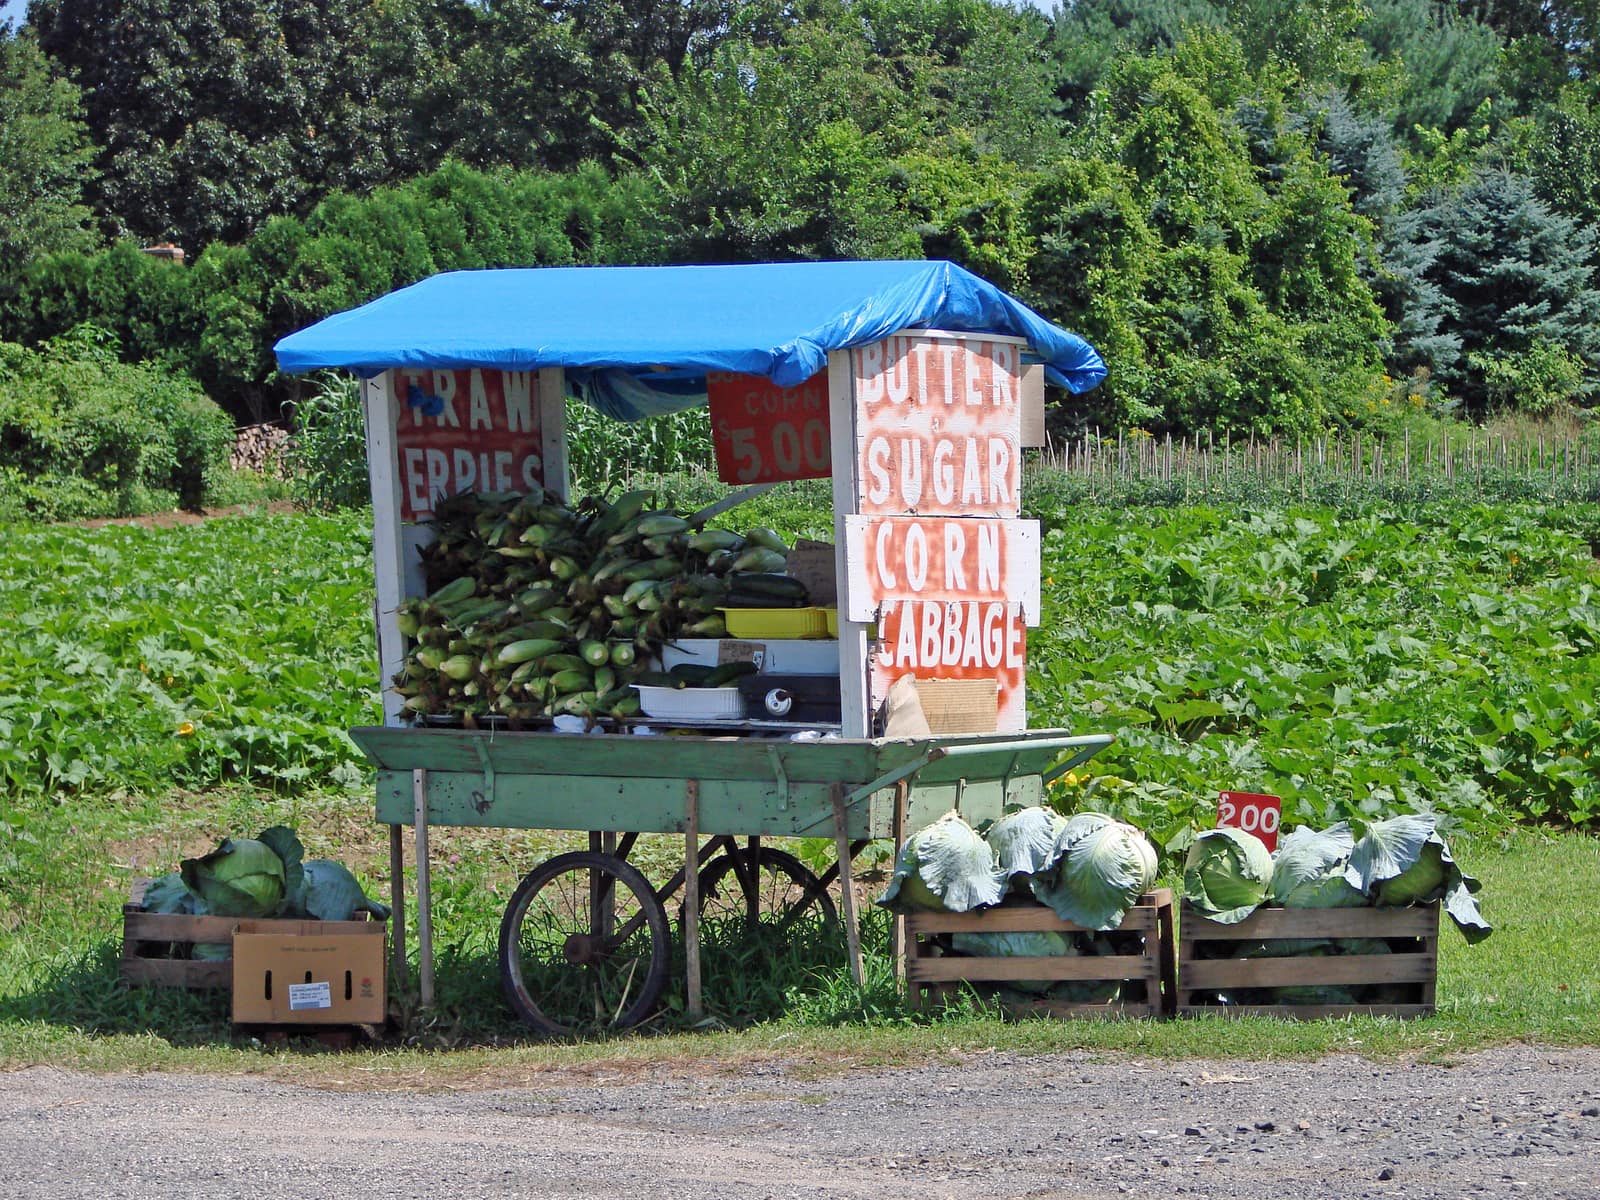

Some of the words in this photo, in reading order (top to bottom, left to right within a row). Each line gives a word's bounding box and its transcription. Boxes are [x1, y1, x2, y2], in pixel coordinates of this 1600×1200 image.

[396, 367, 532, 433] TRAW
[861, 337, 1014, 406] BUTTER
[867, 436, 1011, 506] SUGAR
[875, 520, 1000, 592] CORN
[877, 599, 1023, 669] CABBAGE
